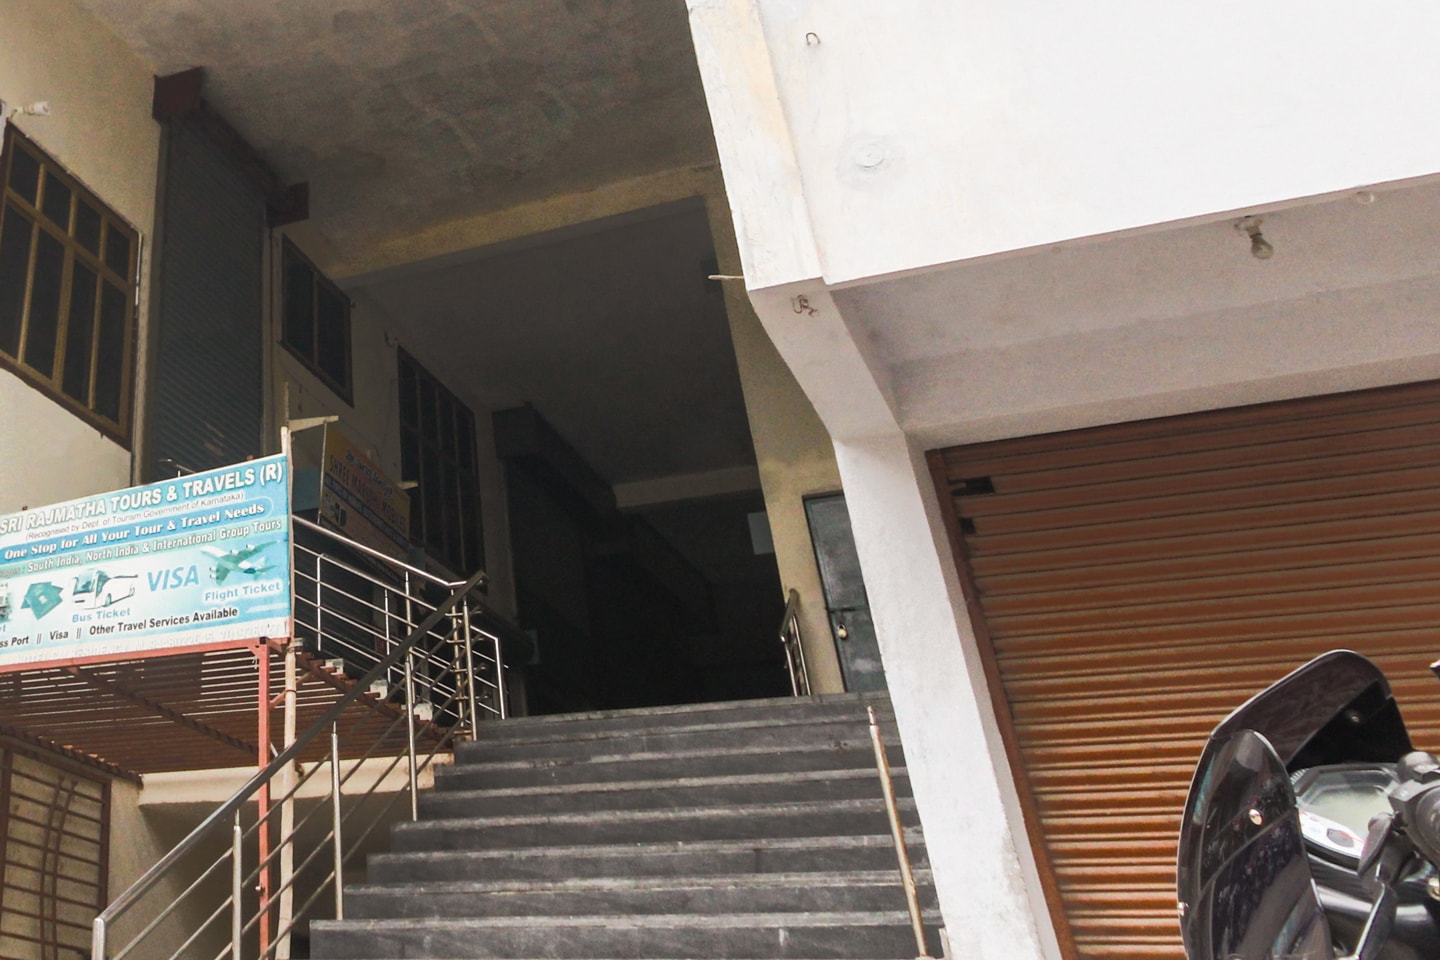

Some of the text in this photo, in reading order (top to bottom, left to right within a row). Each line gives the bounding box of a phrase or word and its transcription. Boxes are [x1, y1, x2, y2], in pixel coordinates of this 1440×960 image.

[0, 462, 283, 536] SRI RAJMATHA TOURS & TRAVELS (R)
[70, 523, 80, 536] by
[103, 517, 111, 526] of
[112, 511, 142, 525] Tourism
[143, 502, 190, 519] Government
[191, 500, 199, 509] of
[200, 490, 245, 507] Karnataka)
[5, 502, 265, 561] One Stop for All Your Tour & Travel Needs
[28, 557, 55, 573] South
[56, 551, 82, 567] India,
[86, 546, 112, 562] North
[115, 542, 139, 557] India
[142, 540, 151, 552] &
[153, 528, 216, 550] International
[219, 526, 250, 540] Group
[252, 520, 282, 533] Tours
[146, 564, 200, 593] VISA
[204, 581, 281, 603] Flight Ticket
[11, 634, 29, 648] Port
[49, 629, 70, 642] Visa
[89, 622, 115, 636] Other
[117, 618, 148, 632] Travel
[149, 613, 191, 629] Services
[192, 606, 238, 623] Available
[71, 607, 132, 623] Bus Ticket
